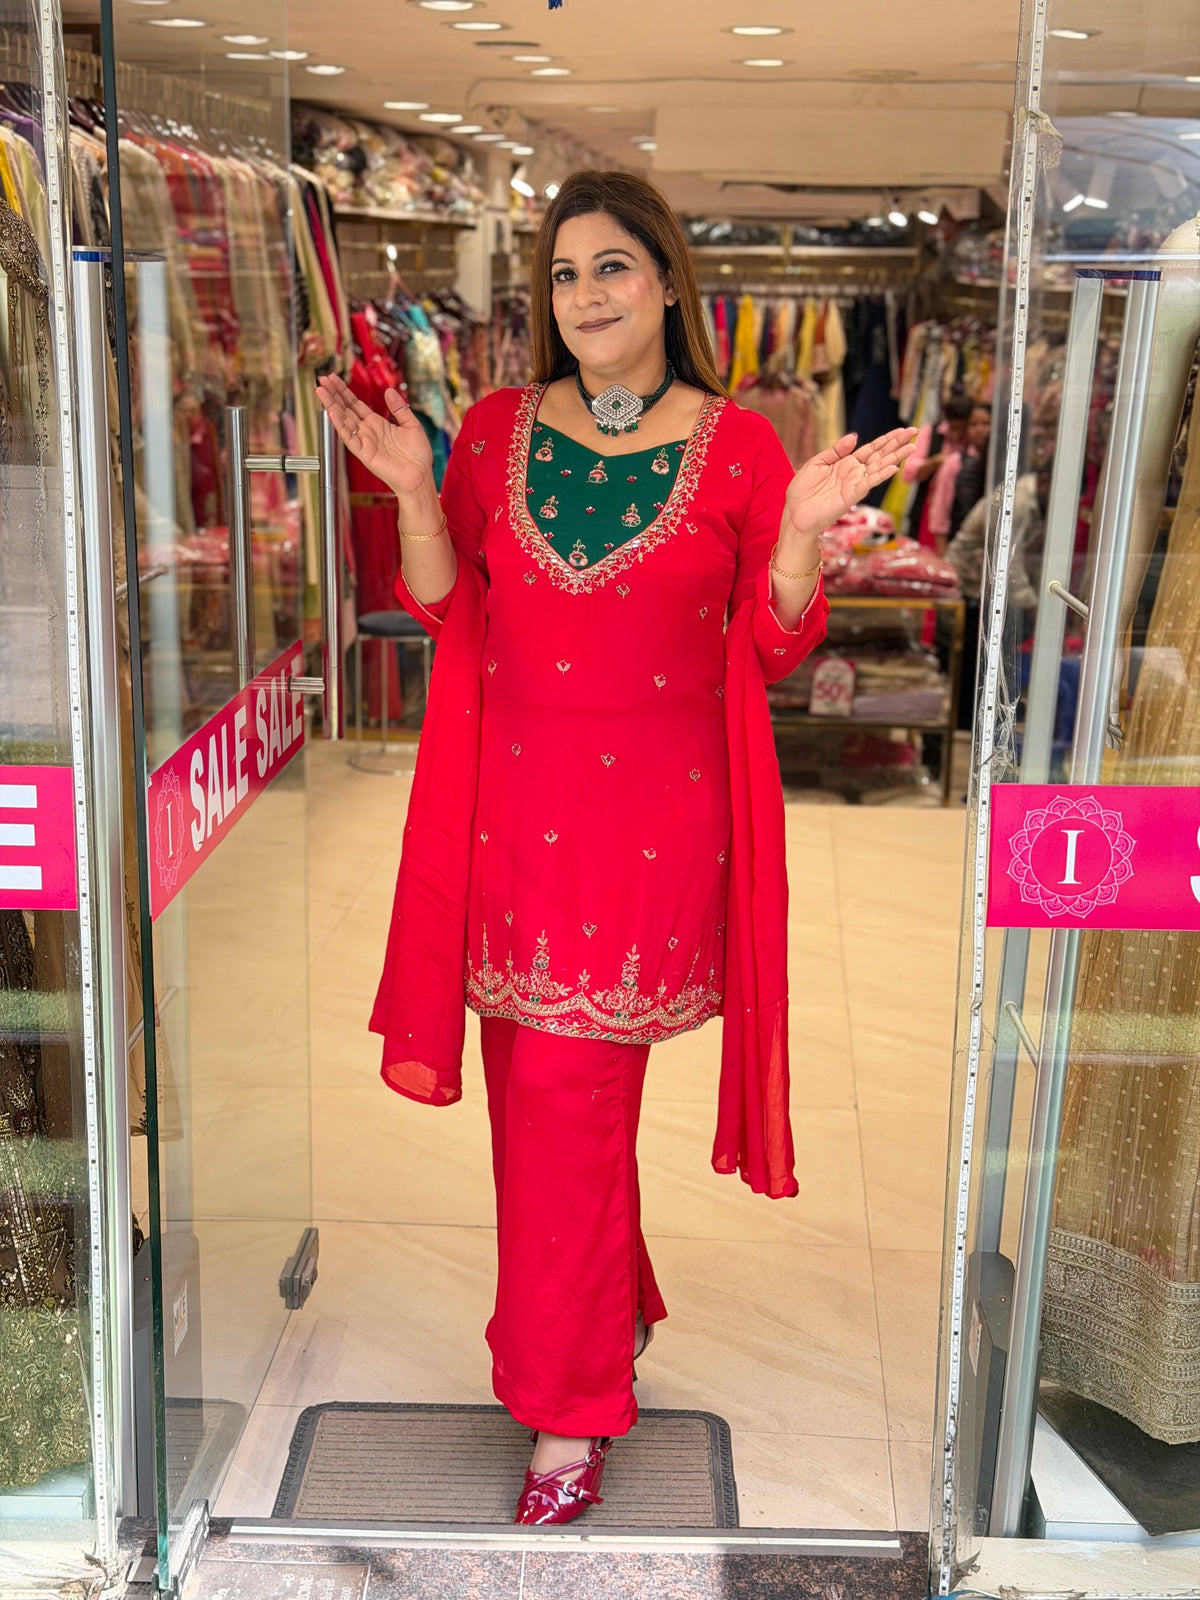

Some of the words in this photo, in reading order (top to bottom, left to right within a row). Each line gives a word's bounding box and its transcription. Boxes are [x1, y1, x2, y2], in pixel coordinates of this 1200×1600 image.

[189, 704, 249, 852] SALE
[256, 653, 303, 779] SALE
[165, 801, 174, 859] I
[1057, 829, 1085, 885] I
